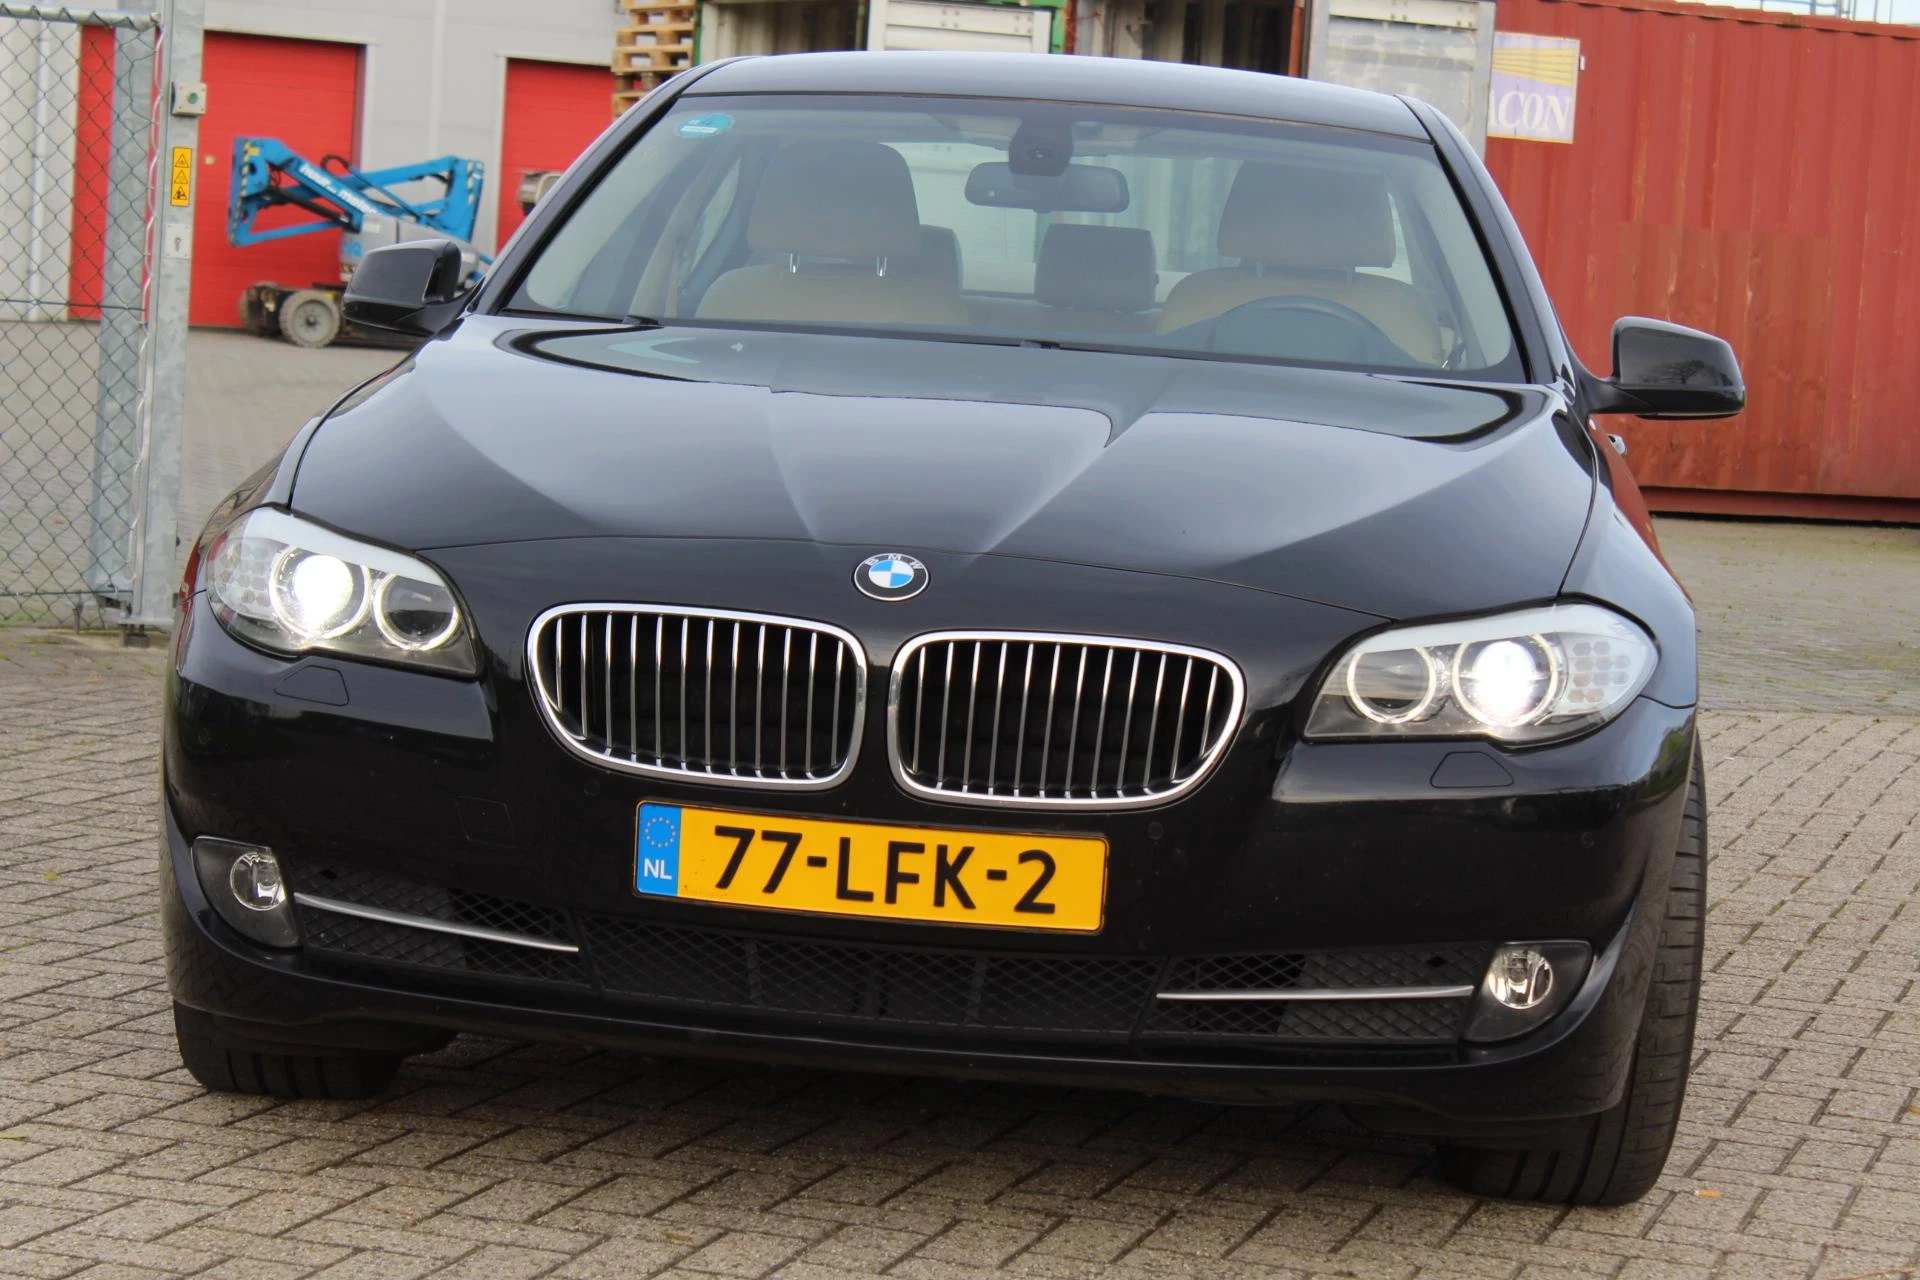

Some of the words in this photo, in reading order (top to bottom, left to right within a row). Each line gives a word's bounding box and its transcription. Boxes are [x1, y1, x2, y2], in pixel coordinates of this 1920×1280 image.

[864, 553, 925, 570] BMW
[643, 857, 673, 881] NL
[714, 825, 1057, 914] 77-LFK-2
